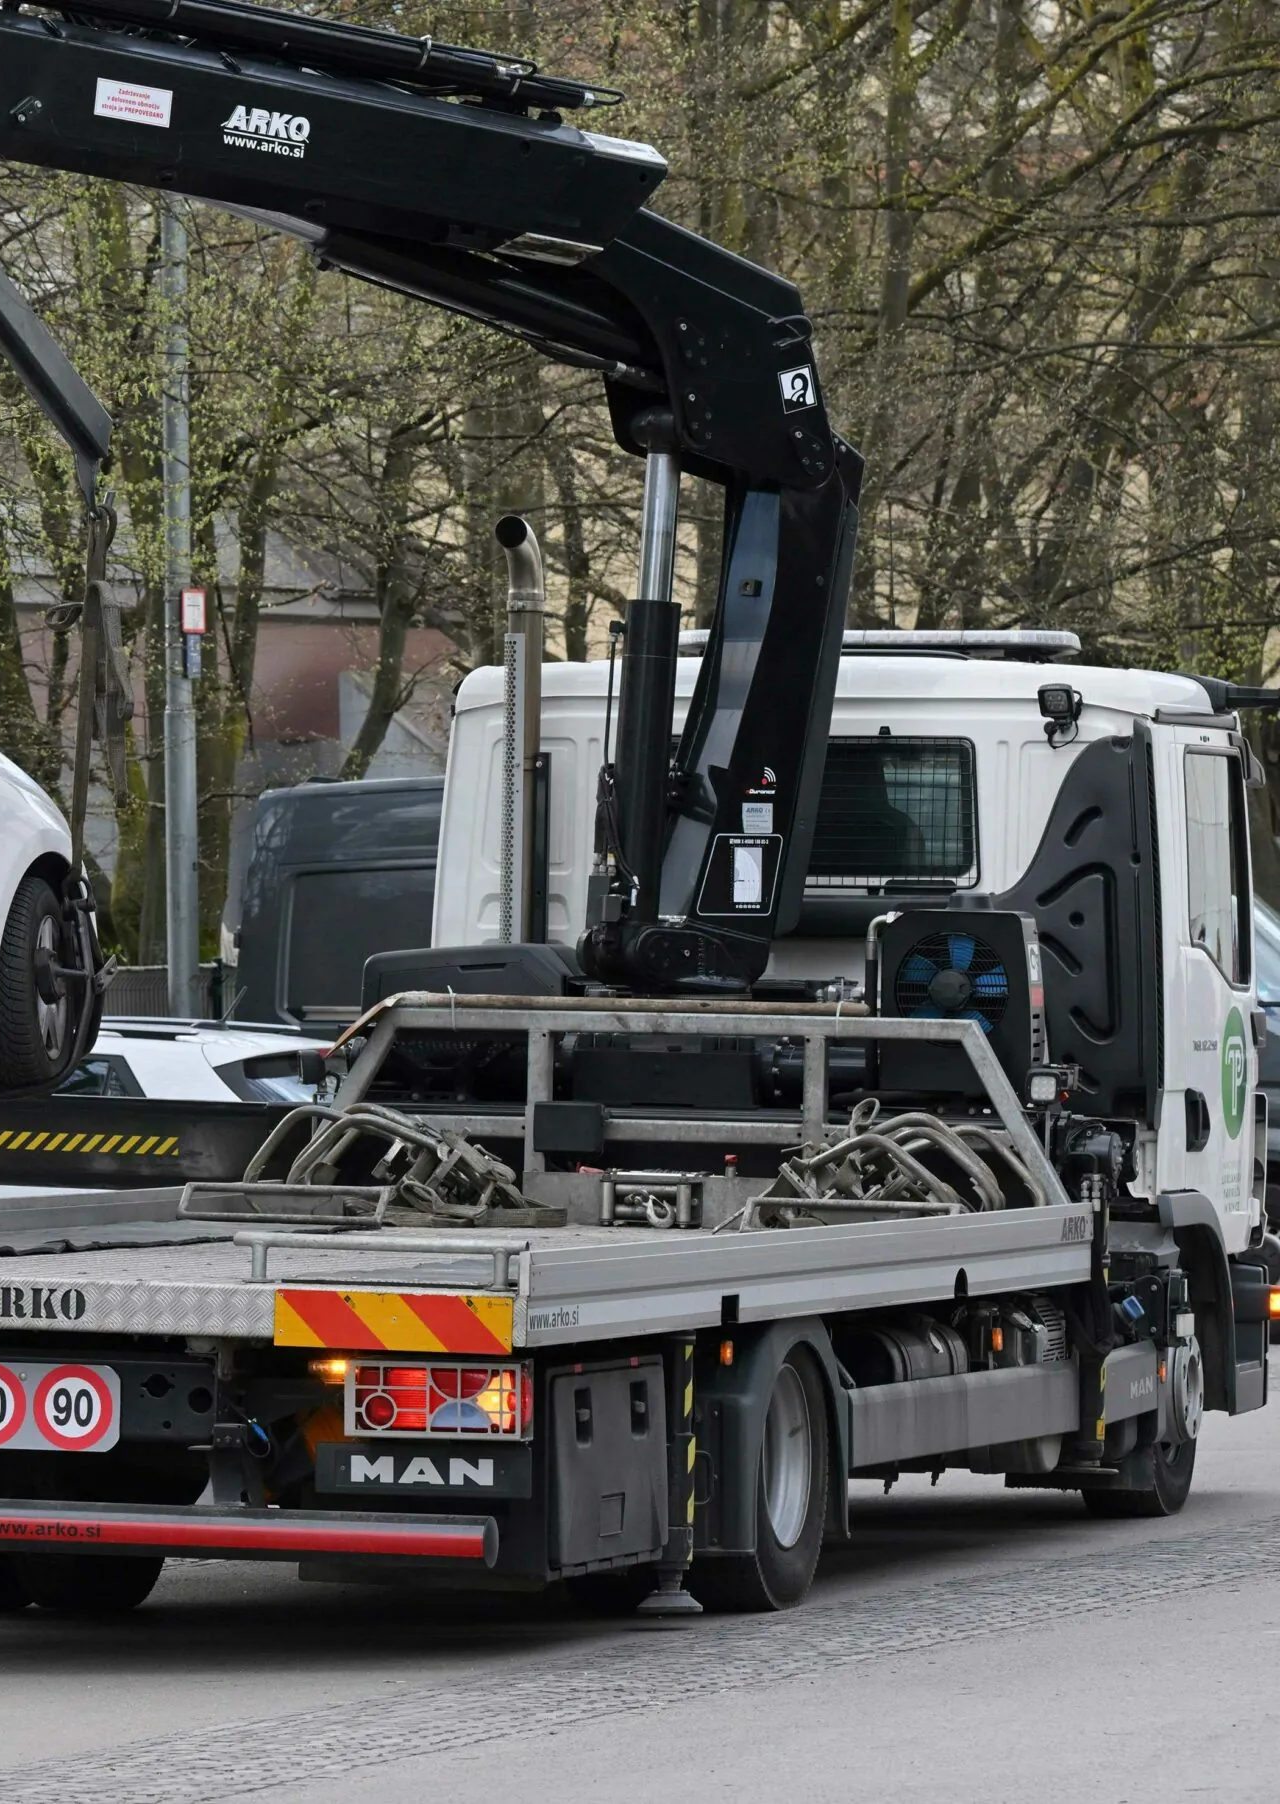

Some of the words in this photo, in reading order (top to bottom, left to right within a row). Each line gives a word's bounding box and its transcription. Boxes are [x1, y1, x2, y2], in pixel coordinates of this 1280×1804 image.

[222, 104, 310, 143] ARKO
[223, 134, 305, 158] www.arko.si
[1060, 1215, 1086, 1242] ARKO
[529, 1305, 580, 1330] www.arko.si
[1130, 1376, 1153, 1399] MAN
[52, 1387, 93, 1428] 90
[350, 1455, 495, 1486] MAN
